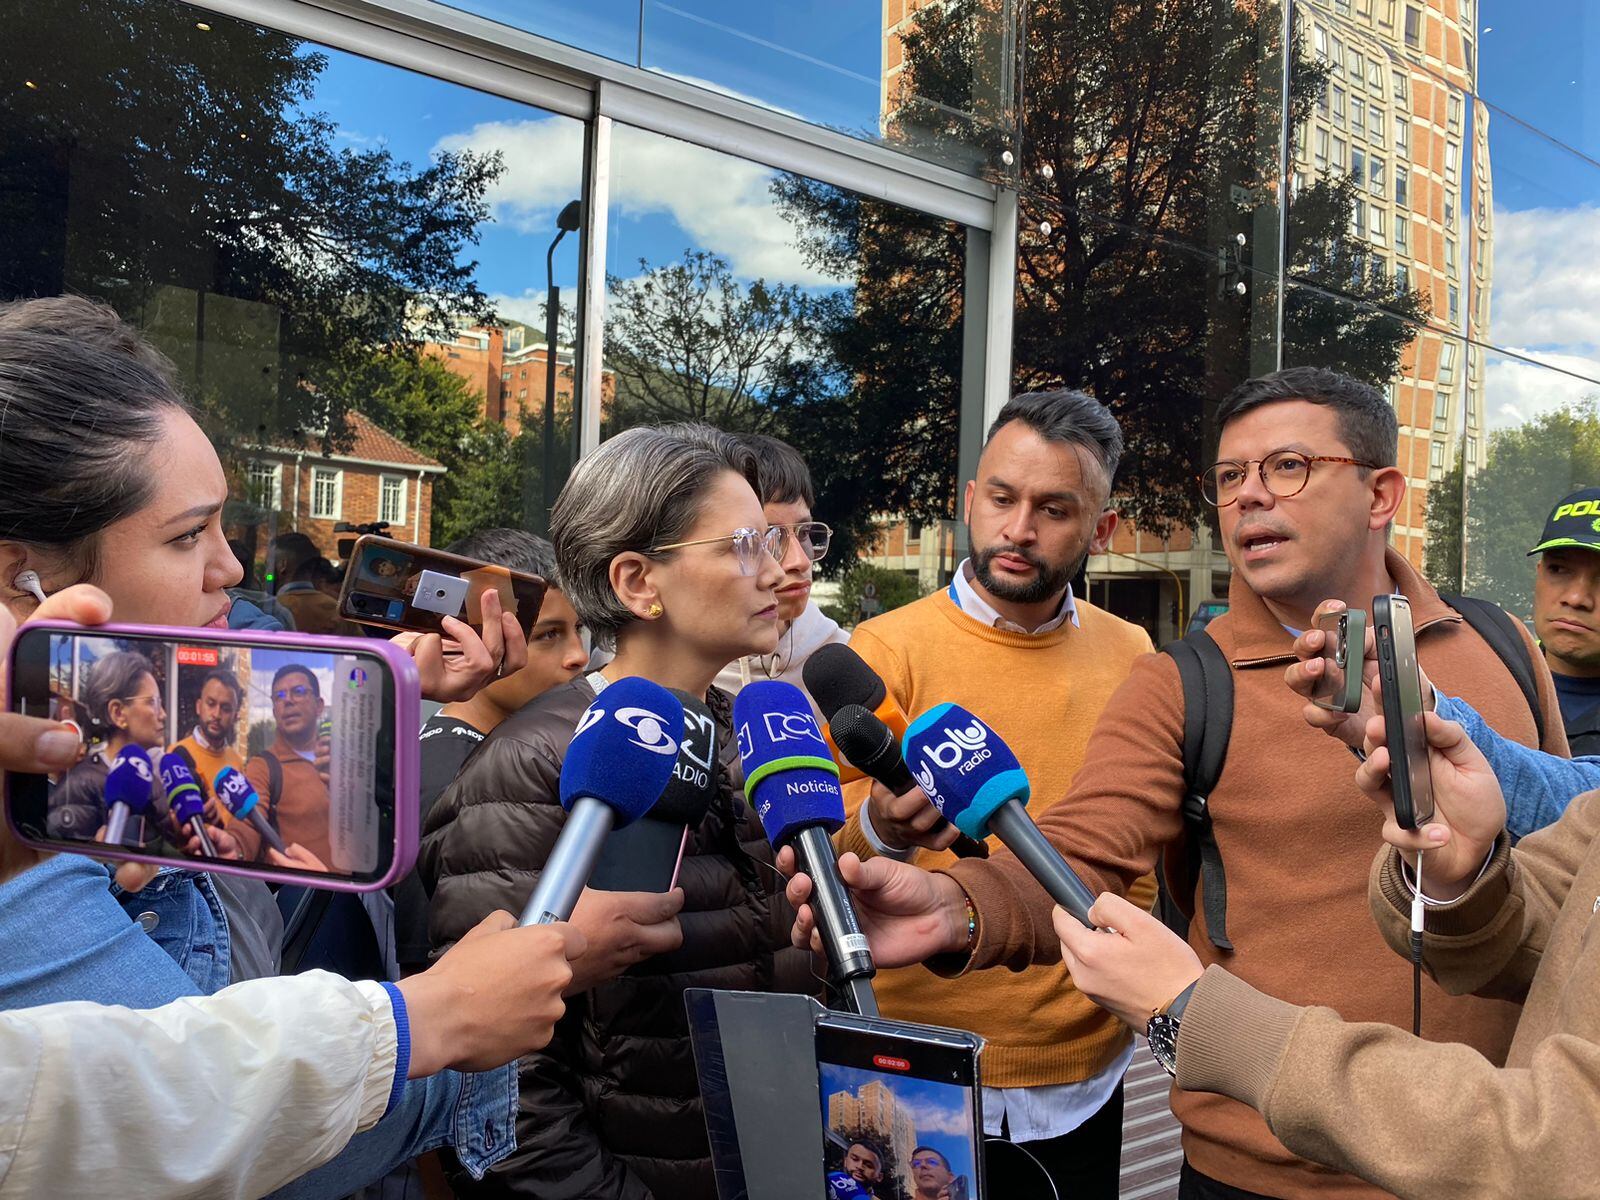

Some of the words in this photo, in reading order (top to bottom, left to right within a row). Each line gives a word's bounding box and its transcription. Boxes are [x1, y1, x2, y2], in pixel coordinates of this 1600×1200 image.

[922, 719, 987, 769] blu
[672, 761, 708, 788] ADIO
[958, 749, 992, 776] radio
[786, 779, 839, 796] Noticias
